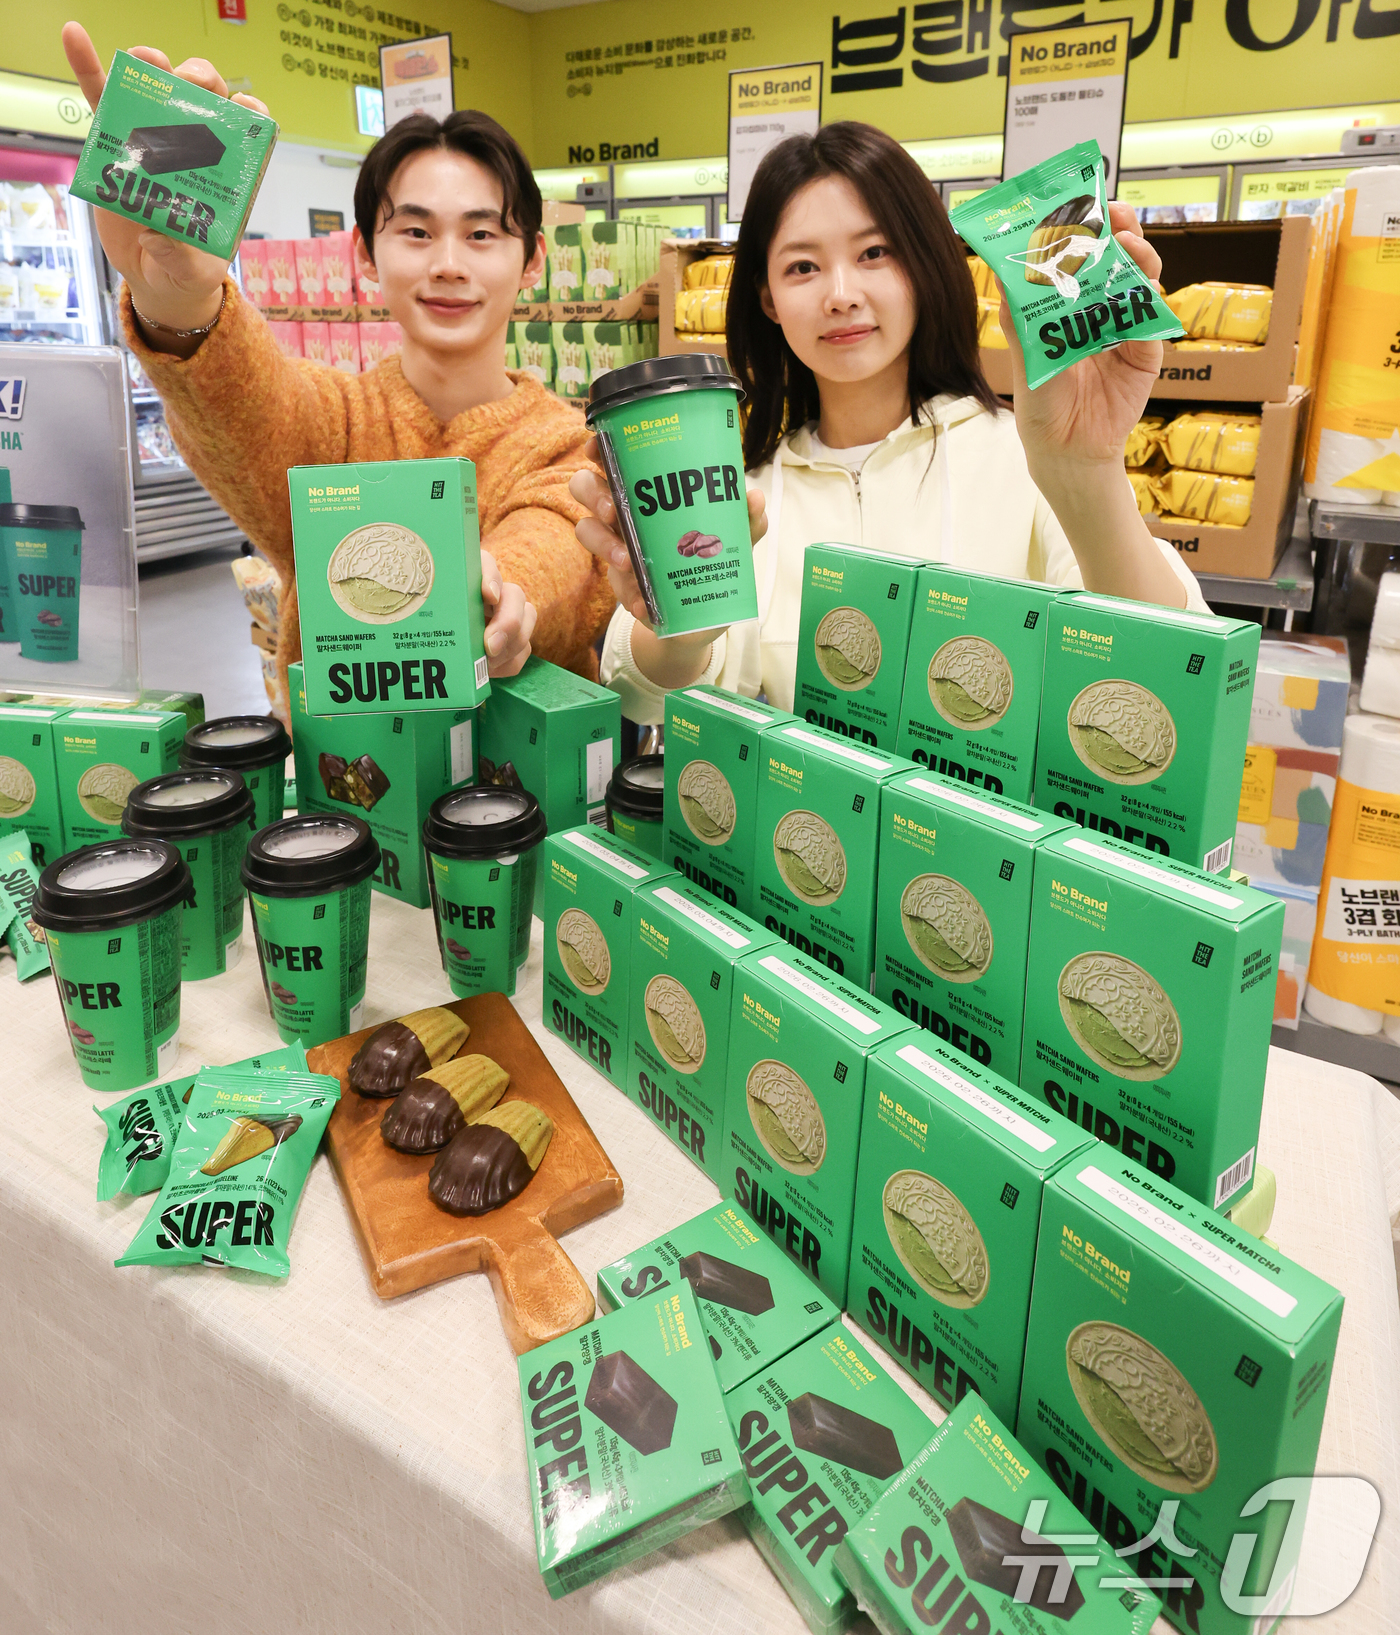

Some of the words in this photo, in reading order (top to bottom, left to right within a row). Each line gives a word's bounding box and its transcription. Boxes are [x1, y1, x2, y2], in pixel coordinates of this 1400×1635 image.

[1021, 46, 1048, 62] No
[1053, 34, 1117, 59] Brand
[124, 65, 140, 79] No
[141, 73, 174, 94] Brand
[739, 83, 760, 97] No
[764, 75, 811, 95] Brand
[99, 131, 123, 147] MATCHA
[568, 145, 595, 164] No
[599, 137, 659, 162] Brand
[95, 163, 216, 244] SUPER
[1000, 197, 1031, 215] Brand
[311, 309, 322, 317] No
[323, 308, 343, 317] Brand
[563, 305, 574, 315] No
[575, 303, 603, 314] Brand
[1021, 300, 1039, 313] MATCHA
[1039, 285, 1159, 360] SUPER
[1158, 365, 1212, 381] rand
[623, 424, 639, 436] No
[640, 414, 679, 433] Brand
[308, 487, 324, 497] No
[326, 485, 360, 496] Brand
[634, 464, 741, 517] SUPER
[26, 541, 47, 549] Brand
[667, 567, 693, 580] MATCHA
[694, 562, 726, 576] ESPRESSO
[726, 559, 740, 572] LATTE
[18, 573, 76, 597] SUPER
[680, 597, 692, 606] 300
[701, 593, 715, 603] (236
[716, 591, 729, 602] kcal)
[928, 589, 941, 599] No
[942, 591, 968, 605] Brand
[316, 643, 362, 652] 말차샌드웨이퍼
[355, 633, 376, 641] WAFERS
[1062, 626, 1078, 638] No
[1079, 628, 1113, 645] Brand
[328, 659, 449, 703] SUPER
[64, 736, 74, 744] No
[75, 737, 96, 745] Brand
[769, 758, 780, 769] No
[781, 762, 803, 779] Brand
[1047, 769, 1068, 783] MATCHA
[1068, 775, 1082, 788] SAND
[1083, 779, 1104, 795] WAFERS
[1361, 805, 1378, 815] No
[1380, 809, 1400, 818] Bra
[893, 813, 906, 826] No
[907, 817, 936, 840] Brand
[1101, 839, 1117, 848] No
[1118, 844, 1154, 861] Brand
[1168, 863, 1196, 879] SUPER
[1195, 873, 1233, 891] MATCHA
[1051, 879, 1069, 896] No
[1070, 887, 1108, 913] Brand
[1341, 887, 1400, 905] 노브랜
[1344, 908, 1377, 926] 3겹
[1347, 928, 1373, 937] 3-PLY
[1336, 951, 1372, 964] 당신이
[1376, 953, 1400, 965] 스마
[58, 976, 122, 1010] PER
[743, 993, 756, 1007] No
[756, 1000, 781, 1027] Brand
[552, 999, 612, 1075] SUPER
[1036, 1039, 1059, 1059] MATCHA
[1059, 1051, 1075, 1069] SAND
[1075, 1061, 1100, 1083] WAFERS
[1036, 1049, 1083, 1085] 말차샌드웨이퍼
[216, 1090, 231, 1101] No
[232, 1092, 262, 1103] Brand
[935, 1048, 950, 1059] No
[949, 1056, 982, 1079] Brand
[993, 1085, 1018, 1103] SUPER
[1017, 1099, 1051, 1124] MATCHA
[638, 1071, 706, 1165] SUPER
[879, 1090, 894, 1109] No
[895, 1103, 929, 1135] Brand
[1172, 1131, 1184, 1144] 2.2
[156, 1200, 275, 1250] SUPER
[725, 1208, 738, 1222] No
[735, 1217, 760, 1244] Brand
[734, 1166, 822, 1280] SUPER
[1121, 1169, 1141, 1184] No
[1141, 1180, 1184, 1211] Brand
[1201, 1219, 1236, 1245] SUPER
[1236, 1242, 1281, 1275] MATCHA
[1062, 1225, 1083, 1247] No
[1084, 1241, 1131, 1284] Brand
[670, 1294, 681, 1312] No
[674, 1310, 692, 1349] Brand
[833, 1336, 848, 1353] No
[845, 1349, 877, 1383] Brand
[866, 1286, 981, 1408] SUPER
[756, 1384, 783, 1412] 말차양갱
[766, 1377, 788, 1402] MATCHA
[973, 1414, 992, 1436] No
[991, 1433, 1030, 1479] Brand
[738, 1410, 849, 1567] SUPER
[915, 1476, 944, 1509] MATCHA
[907, 1485, 942, 1527] 말차양갱
[884, 1525, 1005, 1635] SUP
